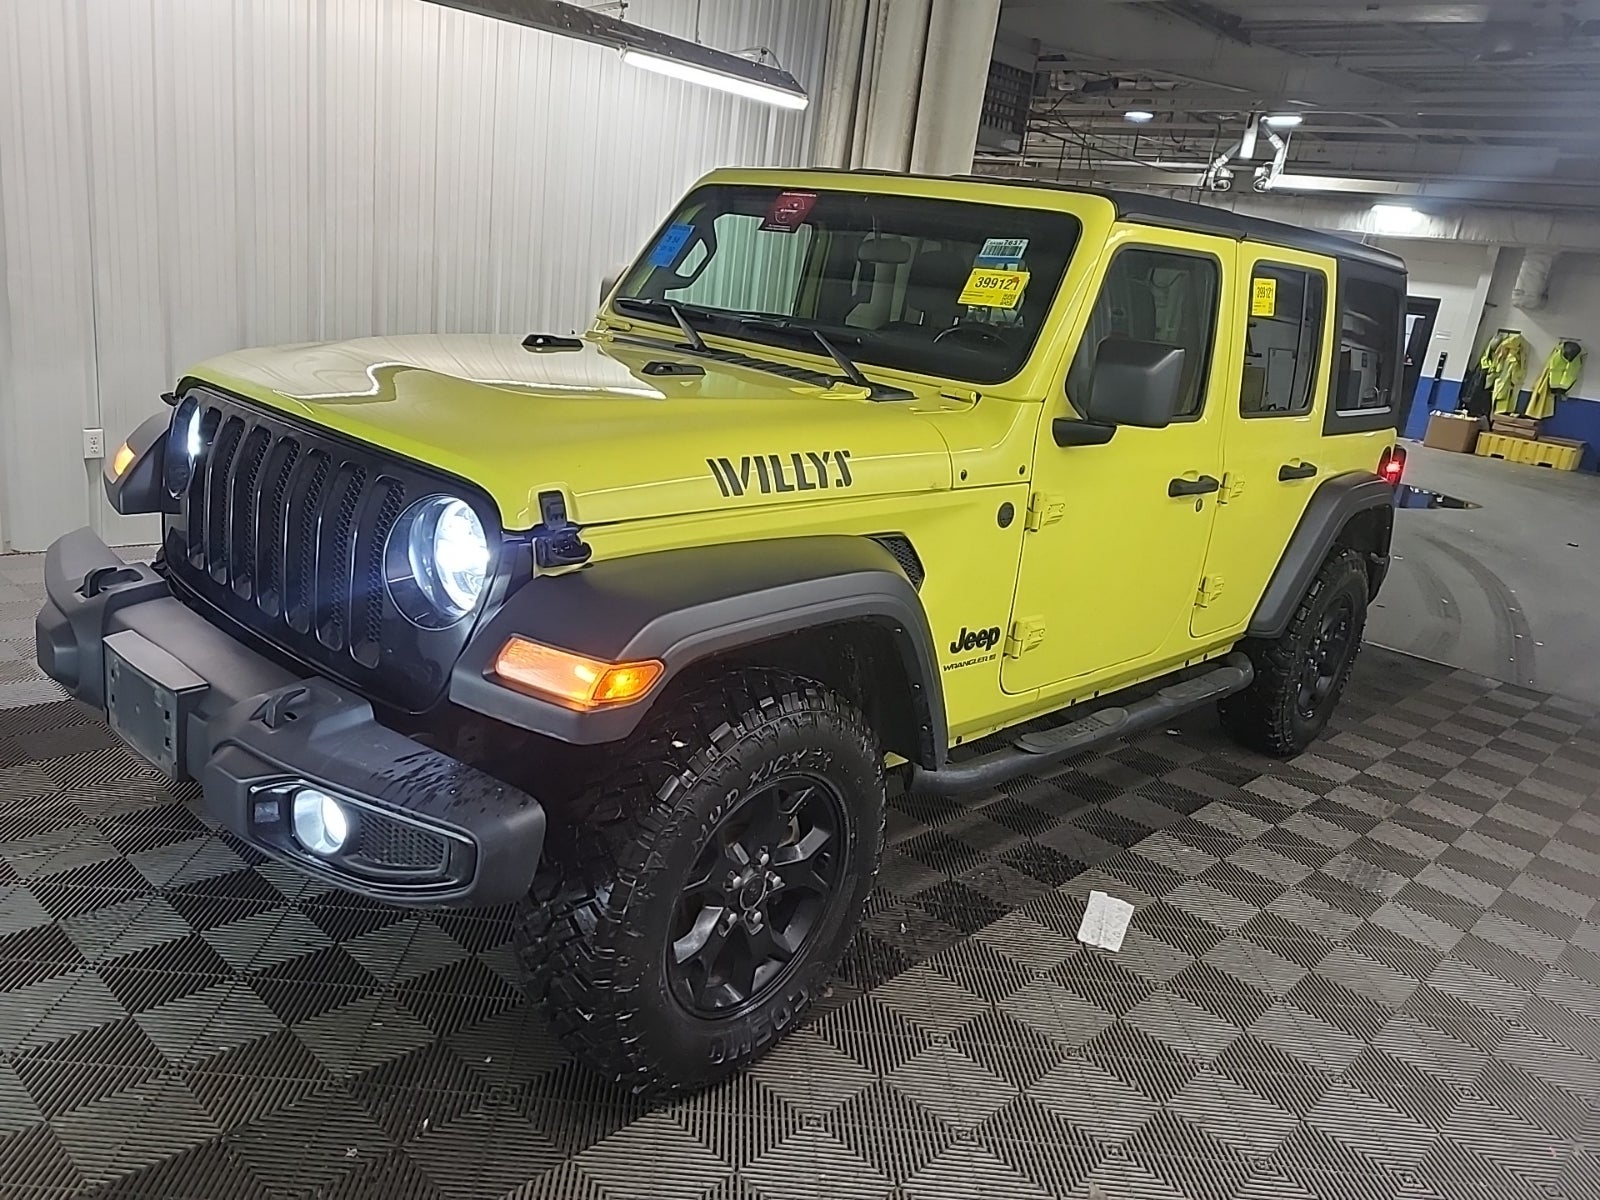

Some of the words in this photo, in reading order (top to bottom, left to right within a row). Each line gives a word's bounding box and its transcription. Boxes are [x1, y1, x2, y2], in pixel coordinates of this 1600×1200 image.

[974, 276, 1021, 291] 399121
[706, 450, 852, 497] WILLYS
[950, 626, 1001, 654] Jeep
[943, 655, 988, 672] WRANGLER
